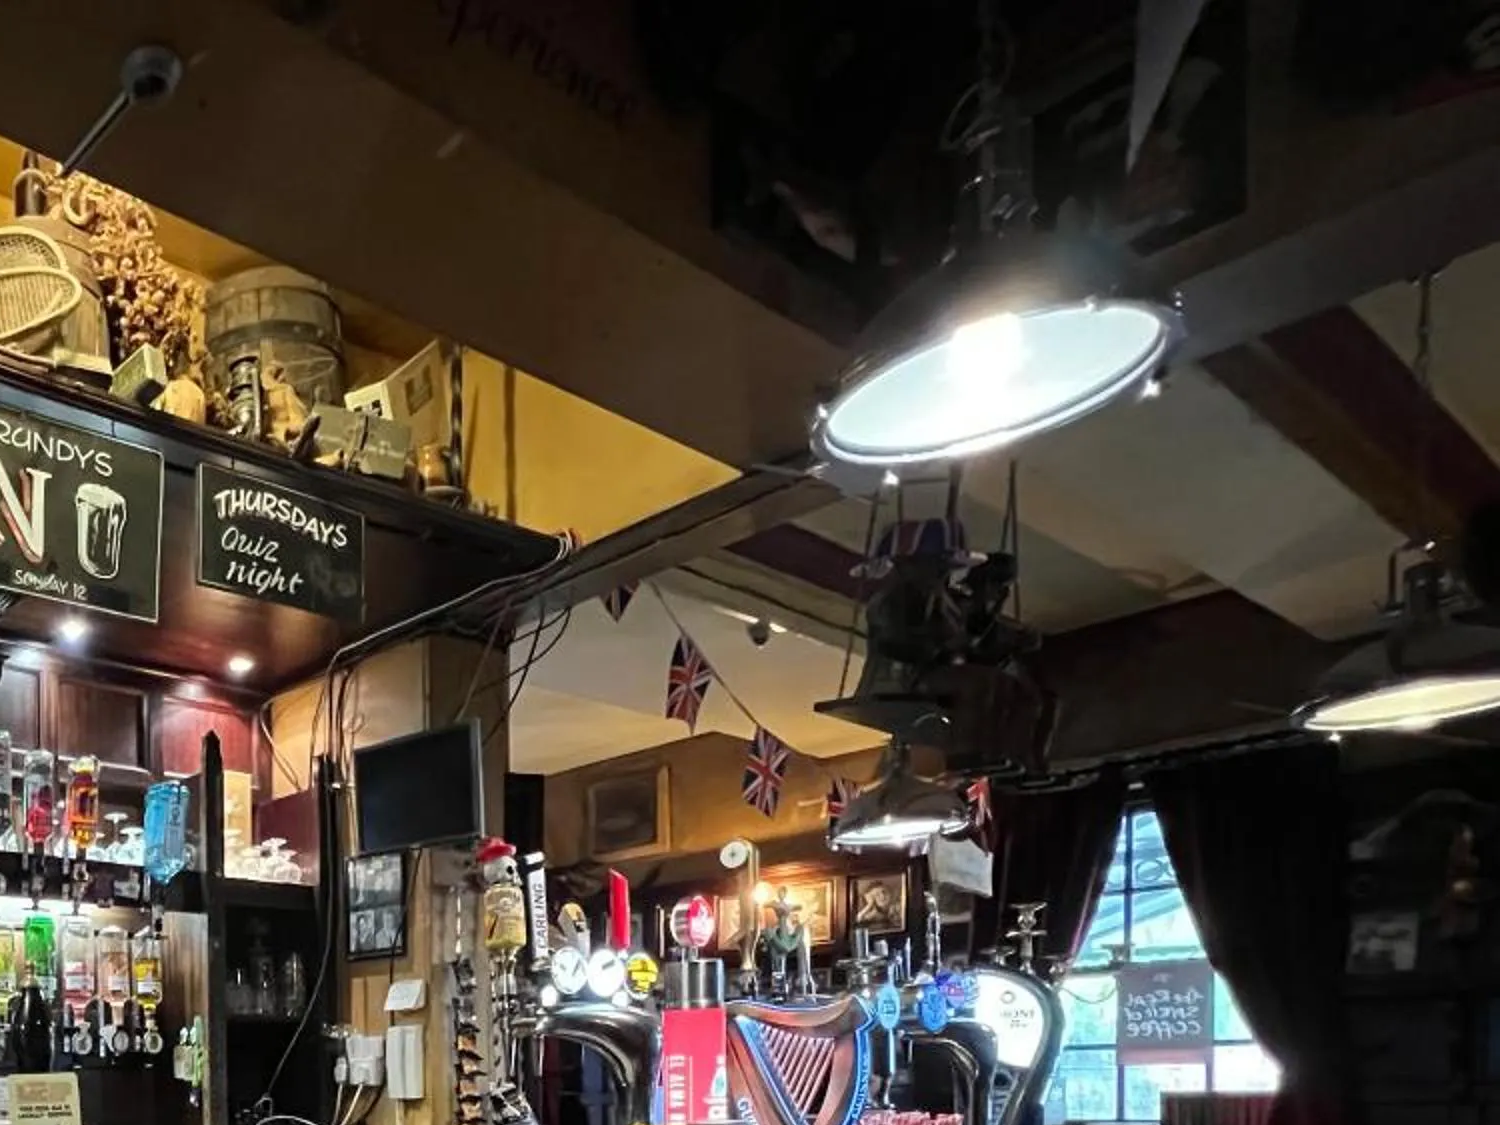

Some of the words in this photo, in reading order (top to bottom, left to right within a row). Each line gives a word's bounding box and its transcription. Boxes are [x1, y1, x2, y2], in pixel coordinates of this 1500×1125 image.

[213, 488, 348, 548] THURSDAYS
[226, 561, 304, 595] night
[532, 881, 549, 951] CARLING
